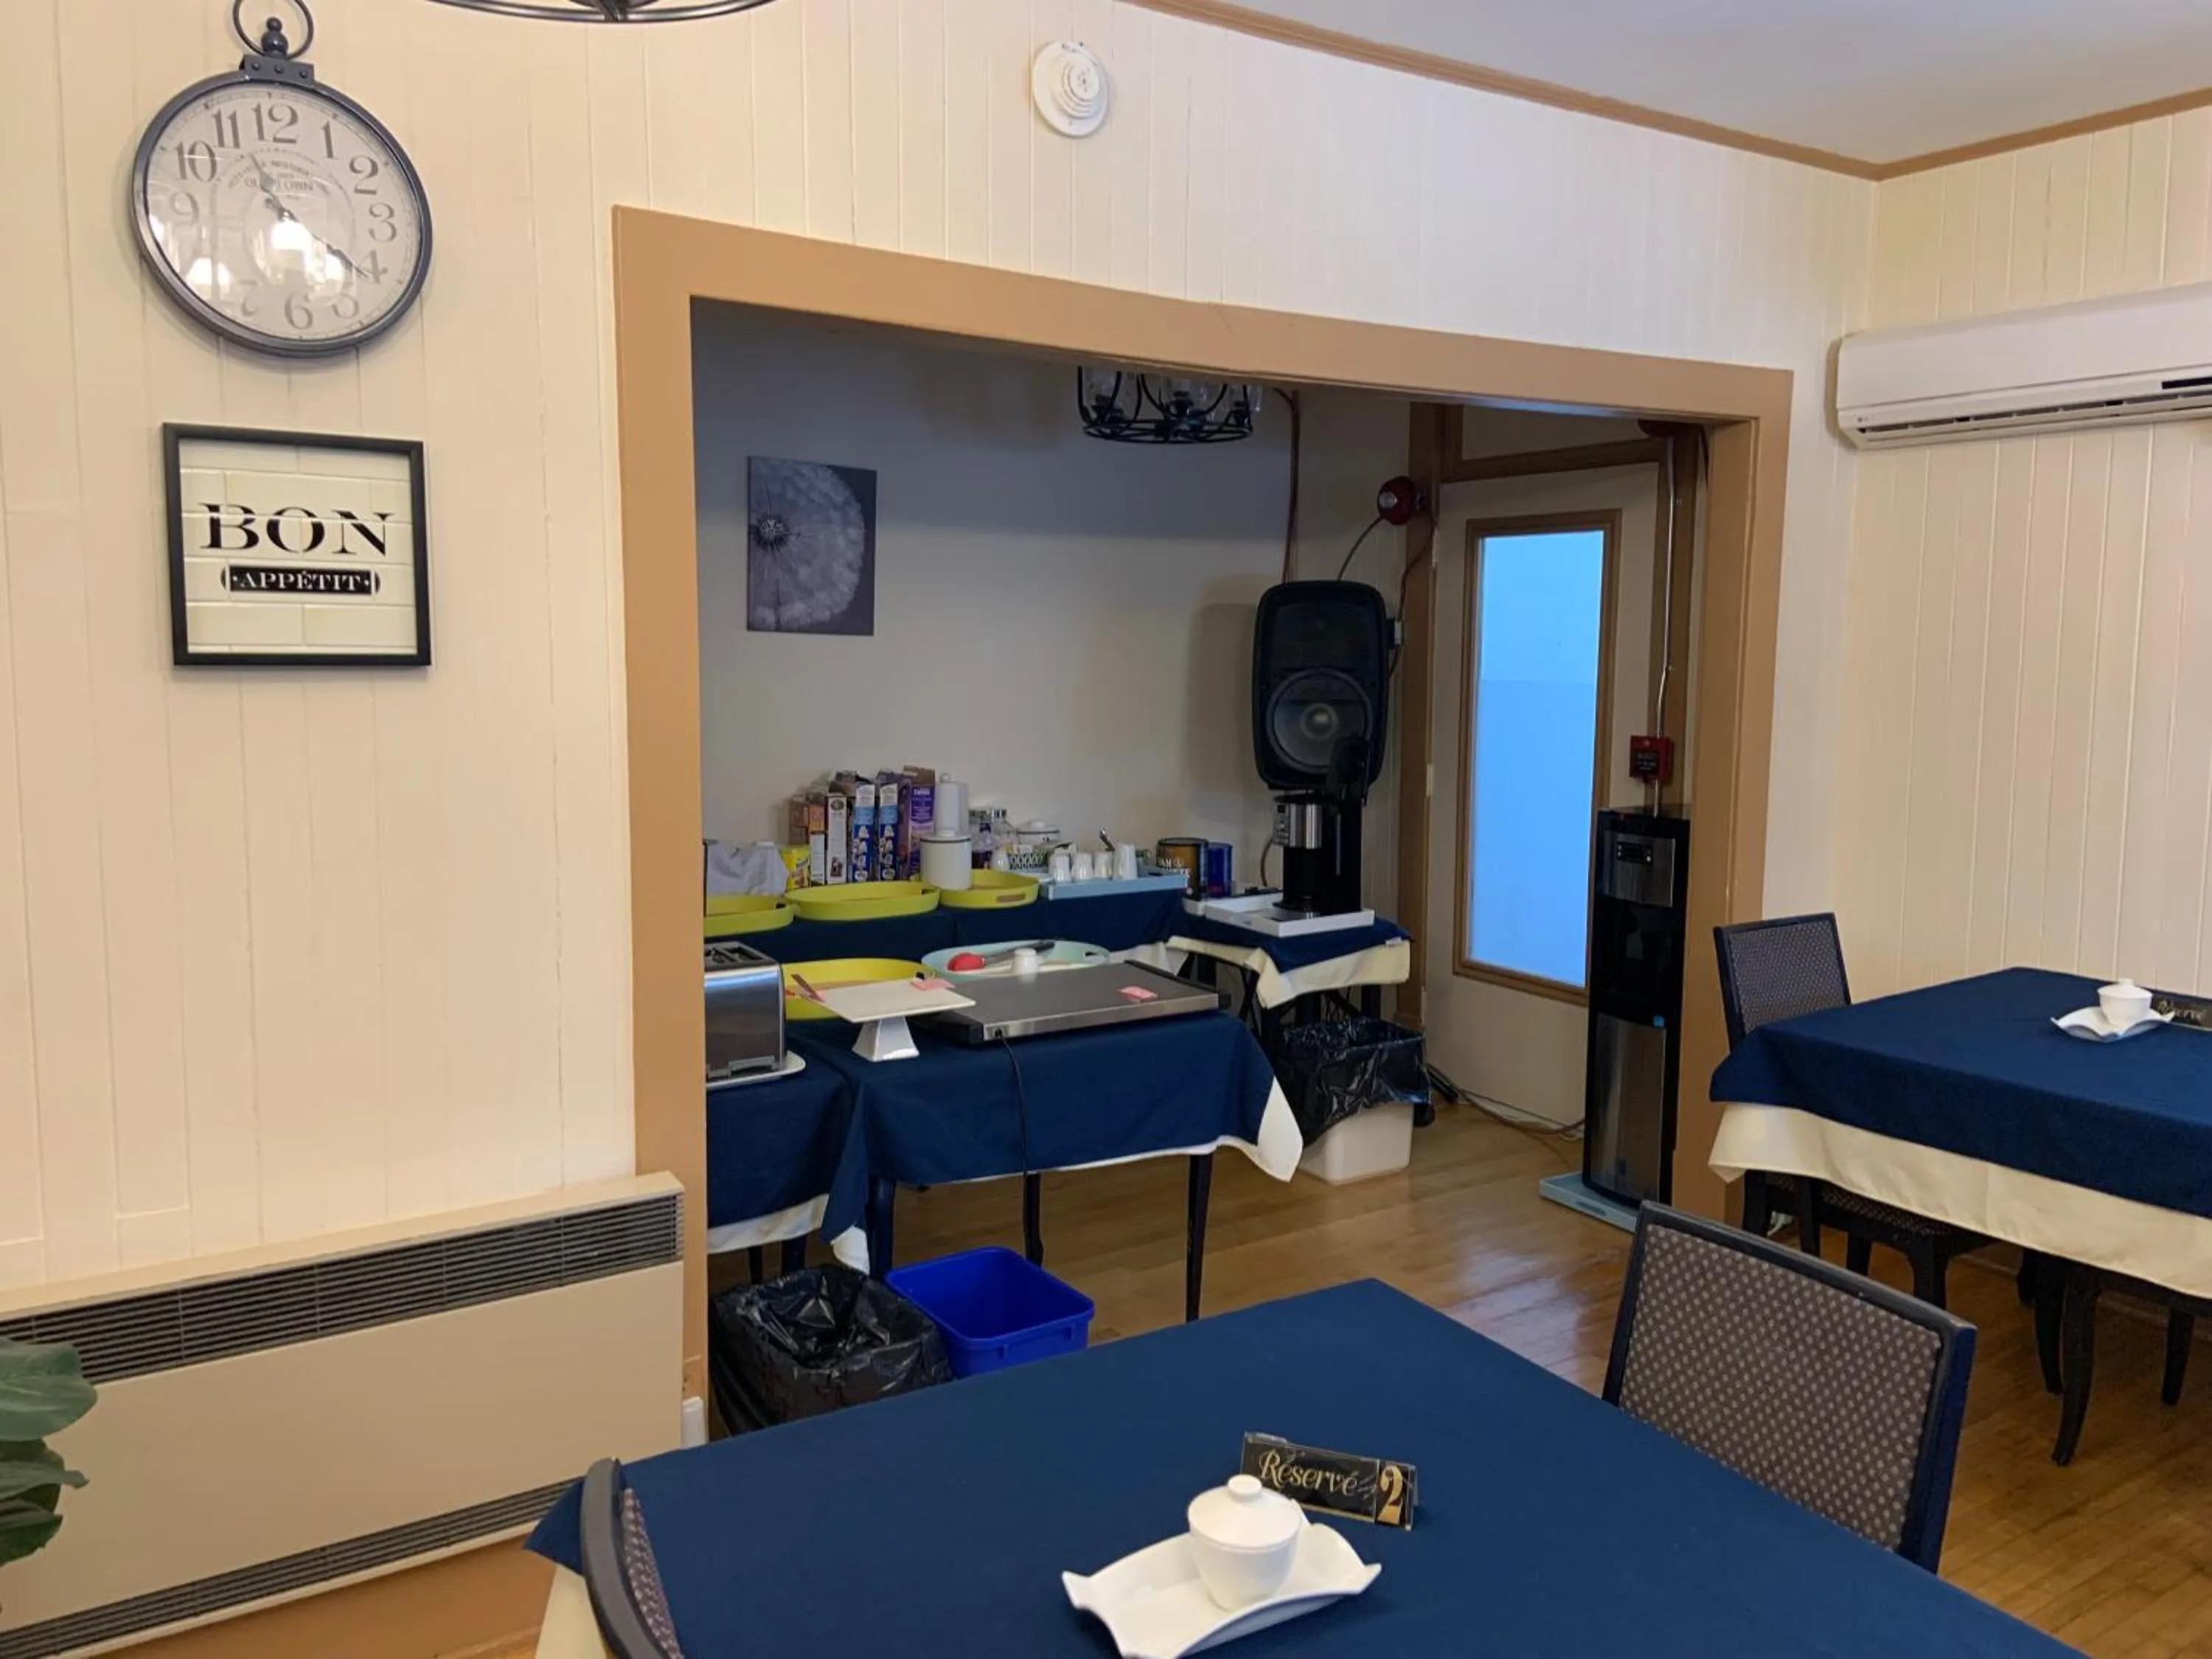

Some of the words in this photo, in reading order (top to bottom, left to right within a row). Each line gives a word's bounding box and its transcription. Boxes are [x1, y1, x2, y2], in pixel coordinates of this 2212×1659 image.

[213, 109, 240, 149] 11
[253, 102, 298, 145] 12
[321, 121, 338, 159] 1
[175, 140, 217, 181] 10
[349, 155, 378, 195] 2
[170, 191, 199, 226] 9
[369, 203, 397, 243] 3
[360, 249, 388, 285] 4
[285, 291, 313, 330] 6
[198, 502, 394, 555] BON
